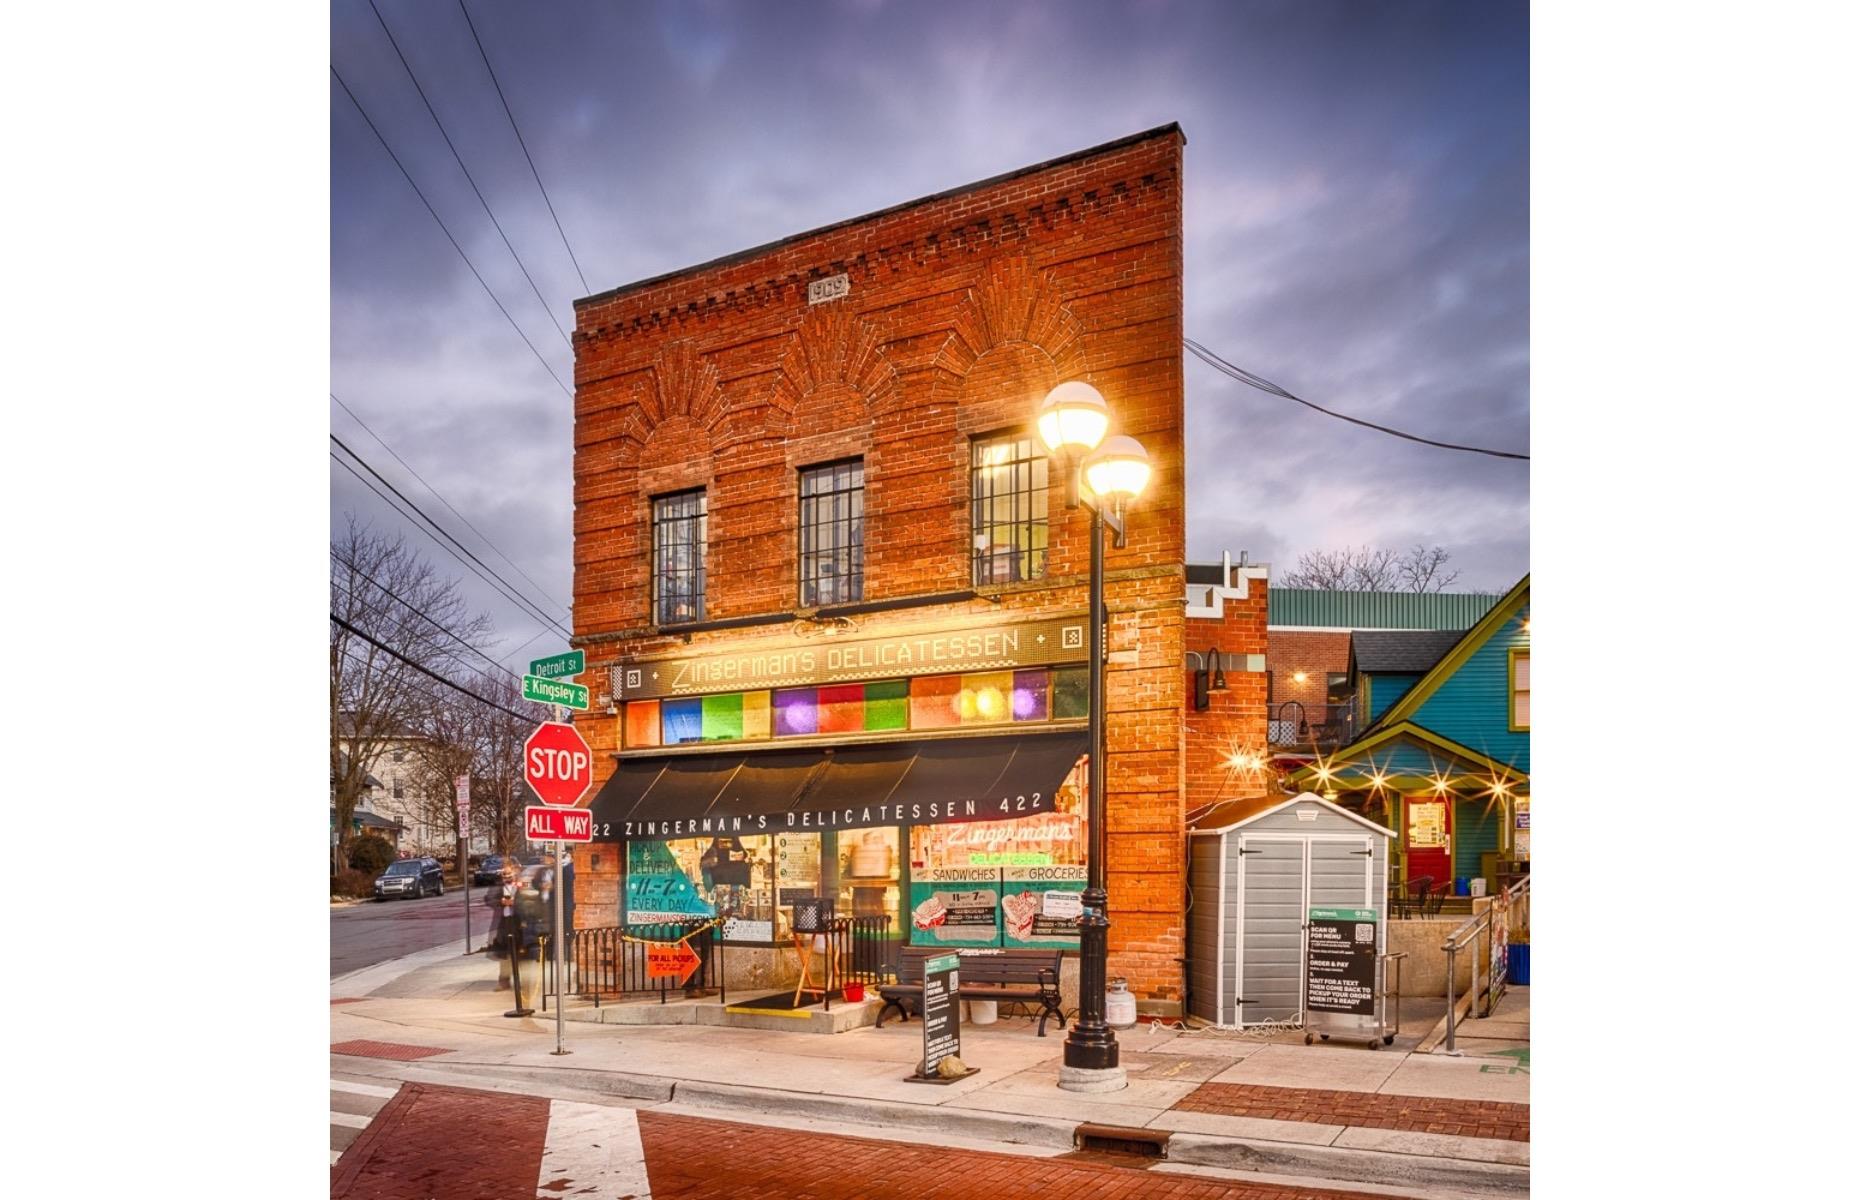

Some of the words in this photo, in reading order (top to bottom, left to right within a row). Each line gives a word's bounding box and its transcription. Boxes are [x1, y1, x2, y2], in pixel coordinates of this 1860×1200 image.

[536, 659, 565, 677] Detroit
[568, 659, 577, 671] St
[671, 651, 815, 688] Zingerman's
[828, 629, 1018, 669] DELICATESSEN
[524, 680, 530, 692] E
[532, 678, 575, 704] Kingsley
[578, 690, 588, 703] St
[530, 747, 587, 781] STOP
[529, 814, 555, 834] ALL
[563, 815, 588, 835] WAY
[625, 814, 766, 835] ZINGERMAN'S
[787, 801, 975, 826] DELICATESSEN
[1000, 793, 1041, 812] 422
[630, 861, 674, 874] DELIVERY
[932, 869, 996, 881] SANDWICHES
[631, 898, 662, 910] EVERY
